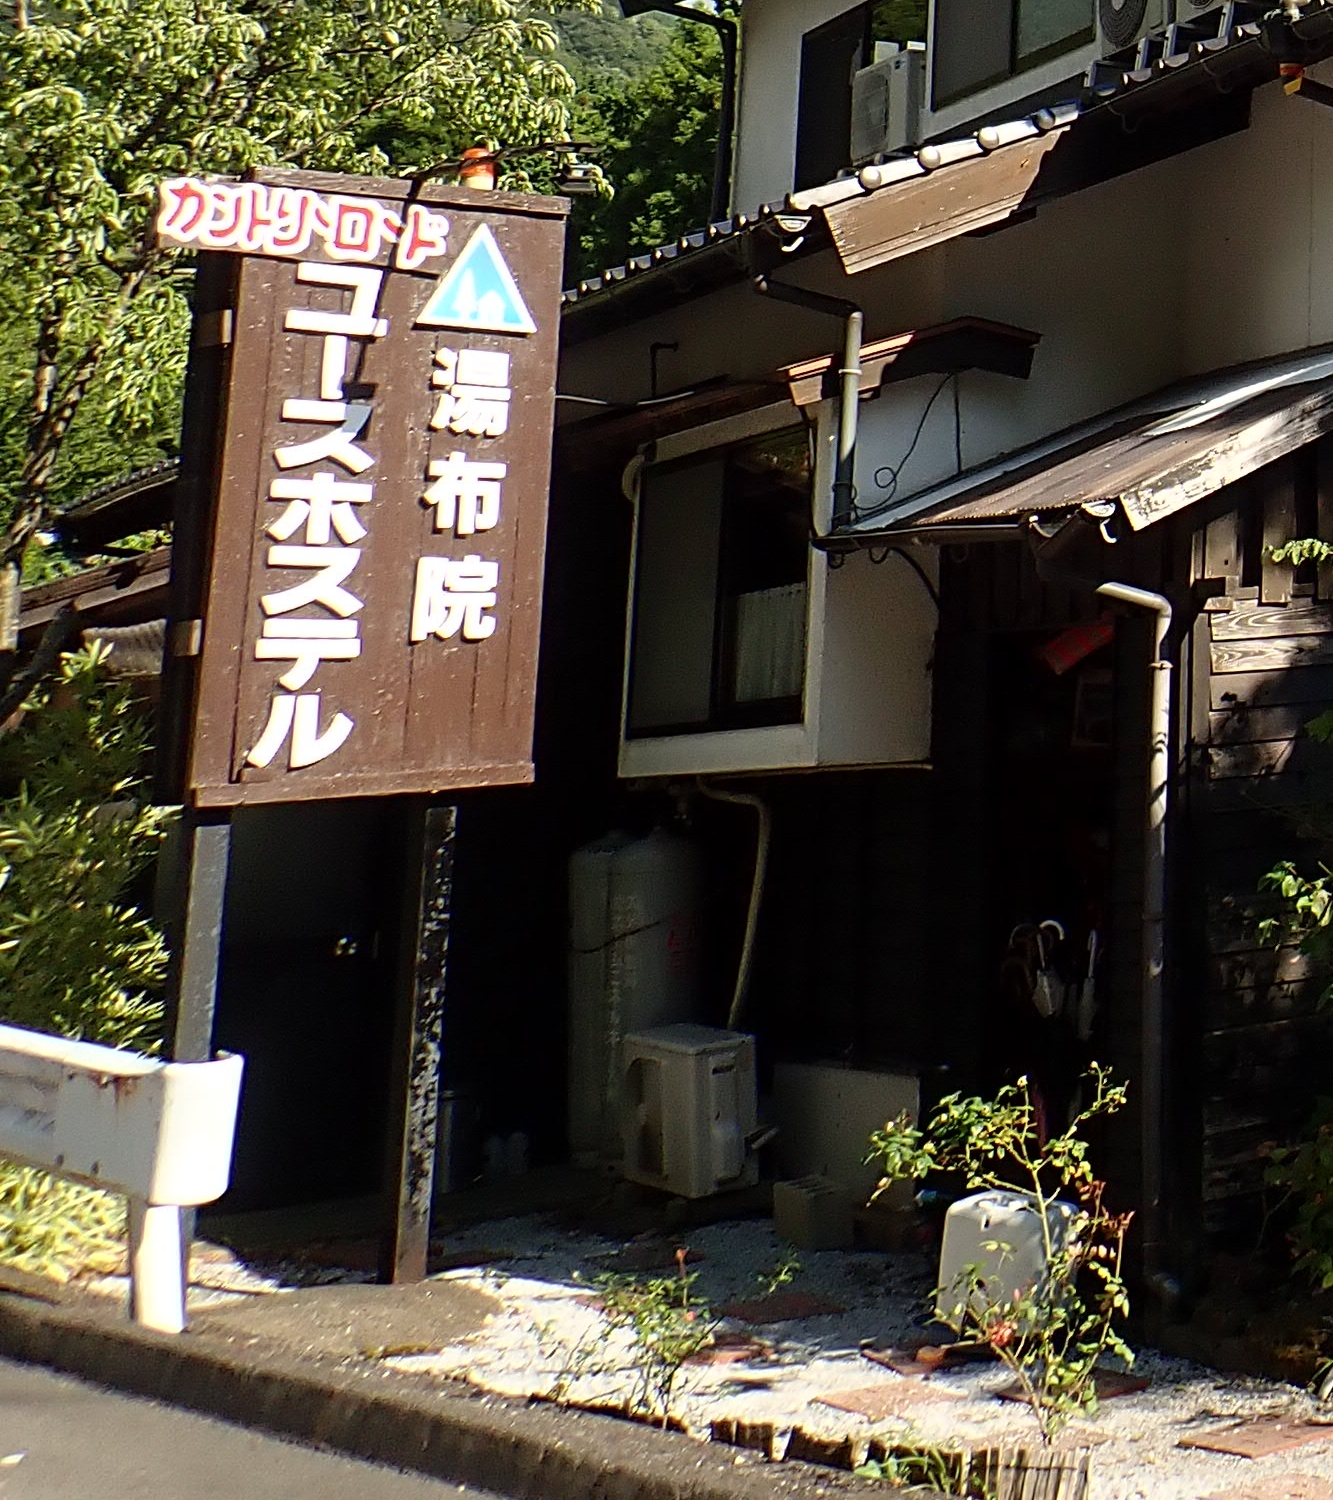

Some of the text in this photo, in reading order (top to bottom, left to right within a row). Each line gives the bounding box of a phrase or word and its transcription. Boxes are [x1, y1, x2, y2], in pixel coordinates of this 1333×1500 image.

[247, 262, 387, 770] ユースホステル
[411, 347, 511, 642] 湯布院
